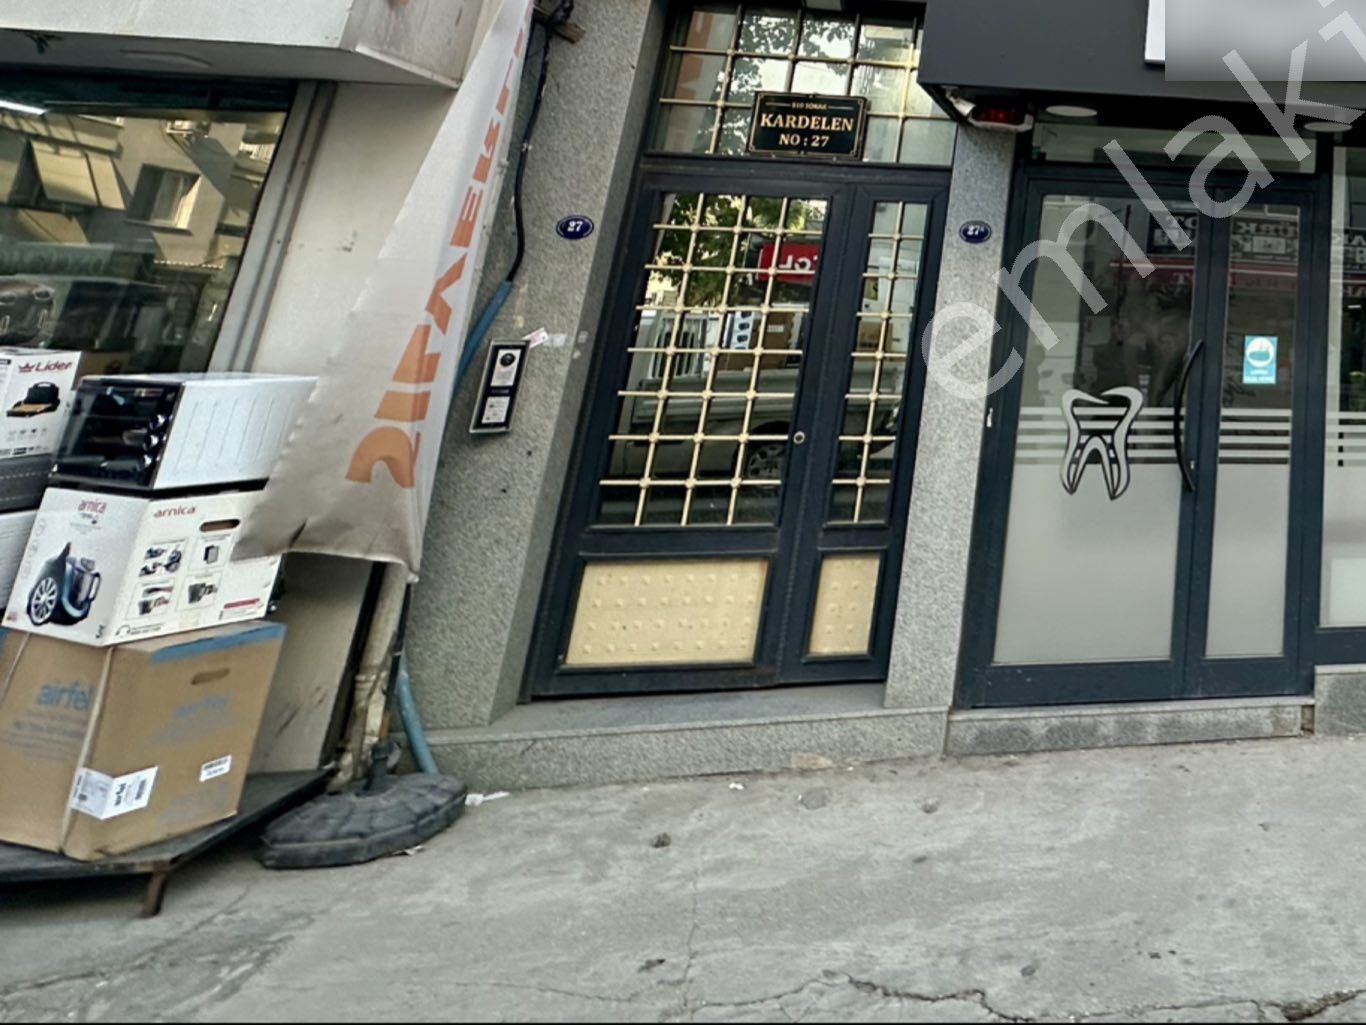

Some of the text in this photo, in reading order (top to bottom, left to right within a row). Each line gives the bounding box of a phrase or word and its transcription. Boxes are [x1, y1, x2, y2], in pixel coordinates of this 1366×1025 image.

[760, 113, 854, 132] KARDELEN
[811, 134, 830, 148] 27
[567, 220, 584, 233] 27
[153, 505, 196, 518] arnica
